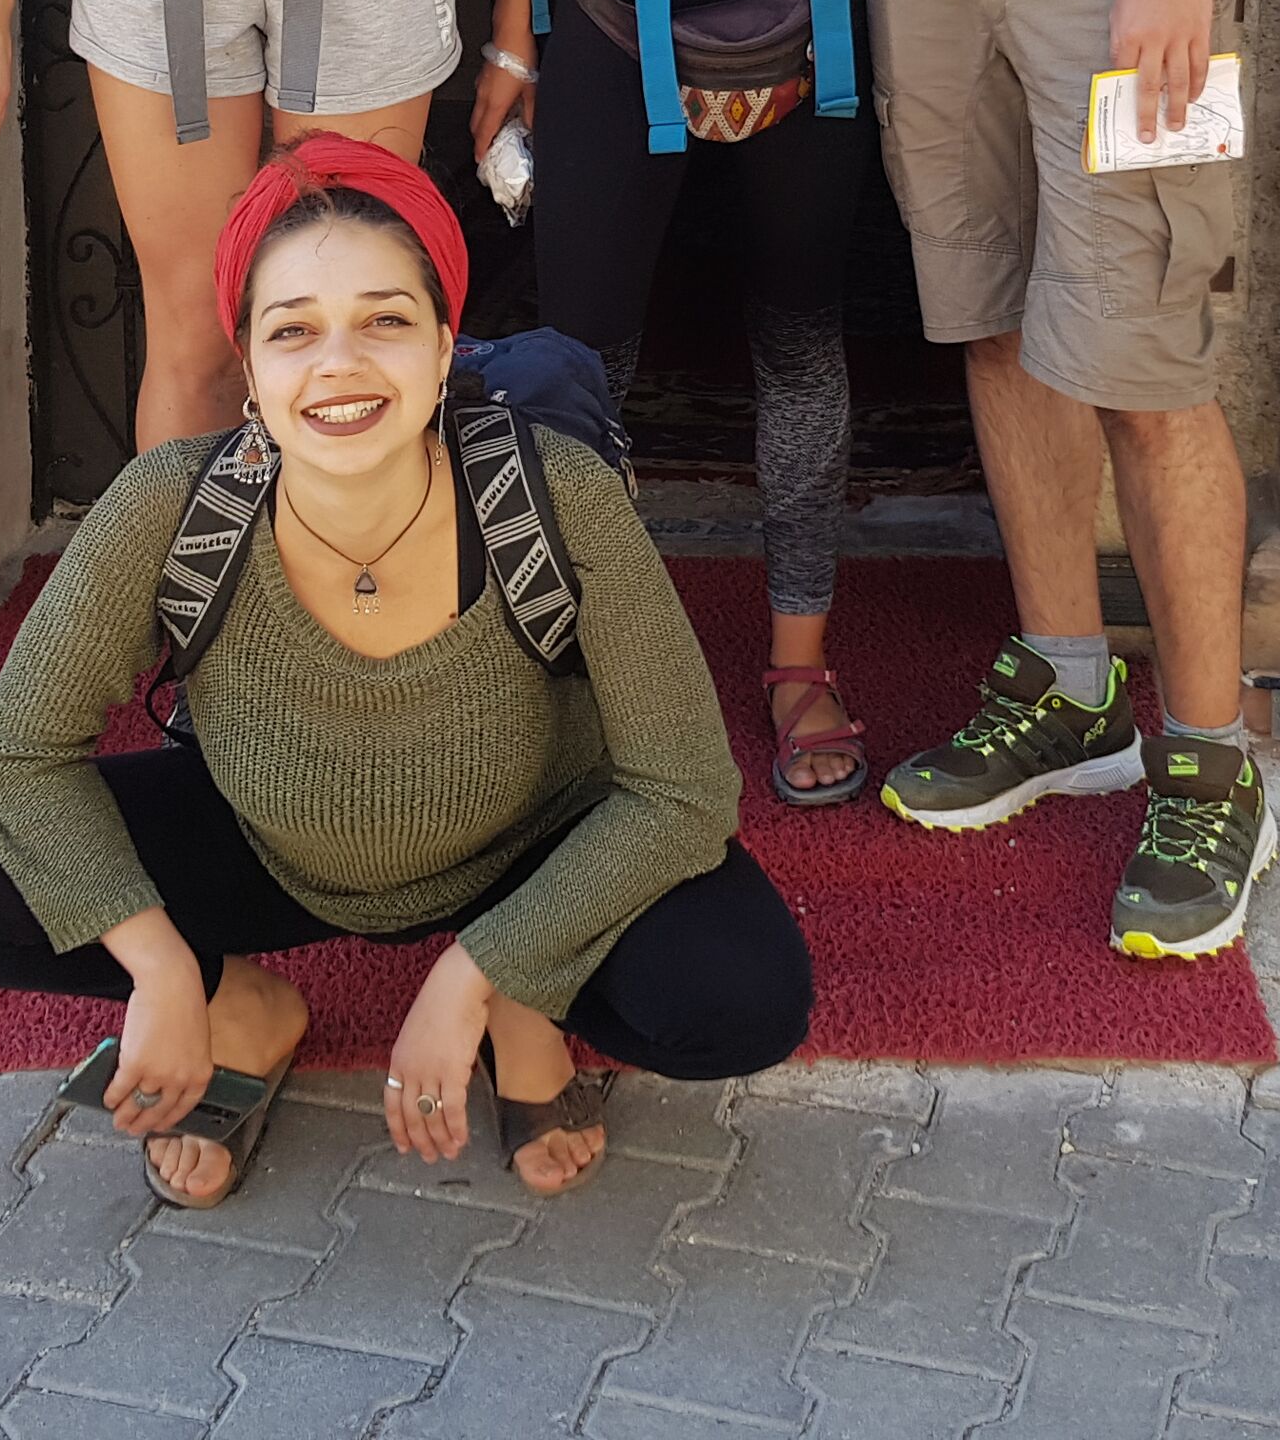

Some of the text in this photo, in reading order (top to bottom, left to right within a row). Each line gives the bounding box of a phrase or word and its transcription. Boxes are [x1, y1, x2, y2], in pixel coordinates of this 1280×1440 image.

[478, 466, 517, 516] invicta
[179, 536, 233, 552] invicta
[508, 548, 544, 596] invicta
